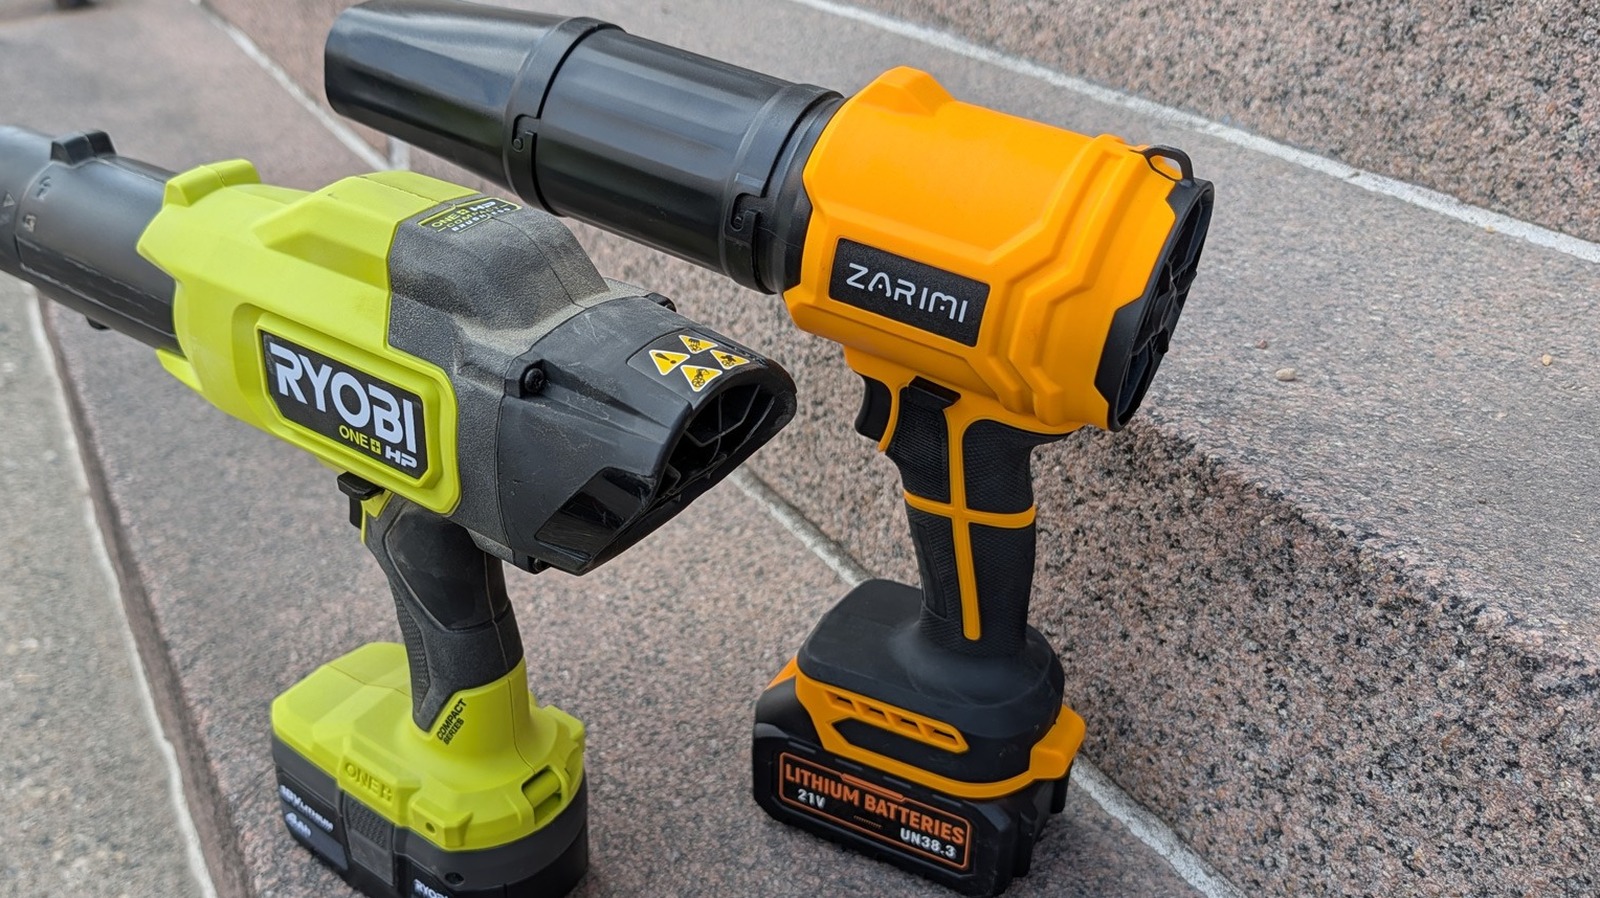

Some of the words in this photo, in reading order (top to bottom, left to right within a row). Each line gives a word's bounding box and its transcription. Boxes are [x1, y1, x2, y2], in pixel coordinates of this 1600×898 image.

[846, 262, 968, 323] ZARIMI
[269, 341, 417, 454] RYOBI
[385, 445, 418, 469] HP
[436, 698, 467, 741] COMPACT
[443, 717, 465, 746] SERIES
[785, 763, 859, 807] LITHIUM
[864, 793, 965, 845] BATTERIES
[797, 788, 826, 810] 21V
[900, 827, 957, 859] UN38.3
[413, 878, 449, 898] RYO
